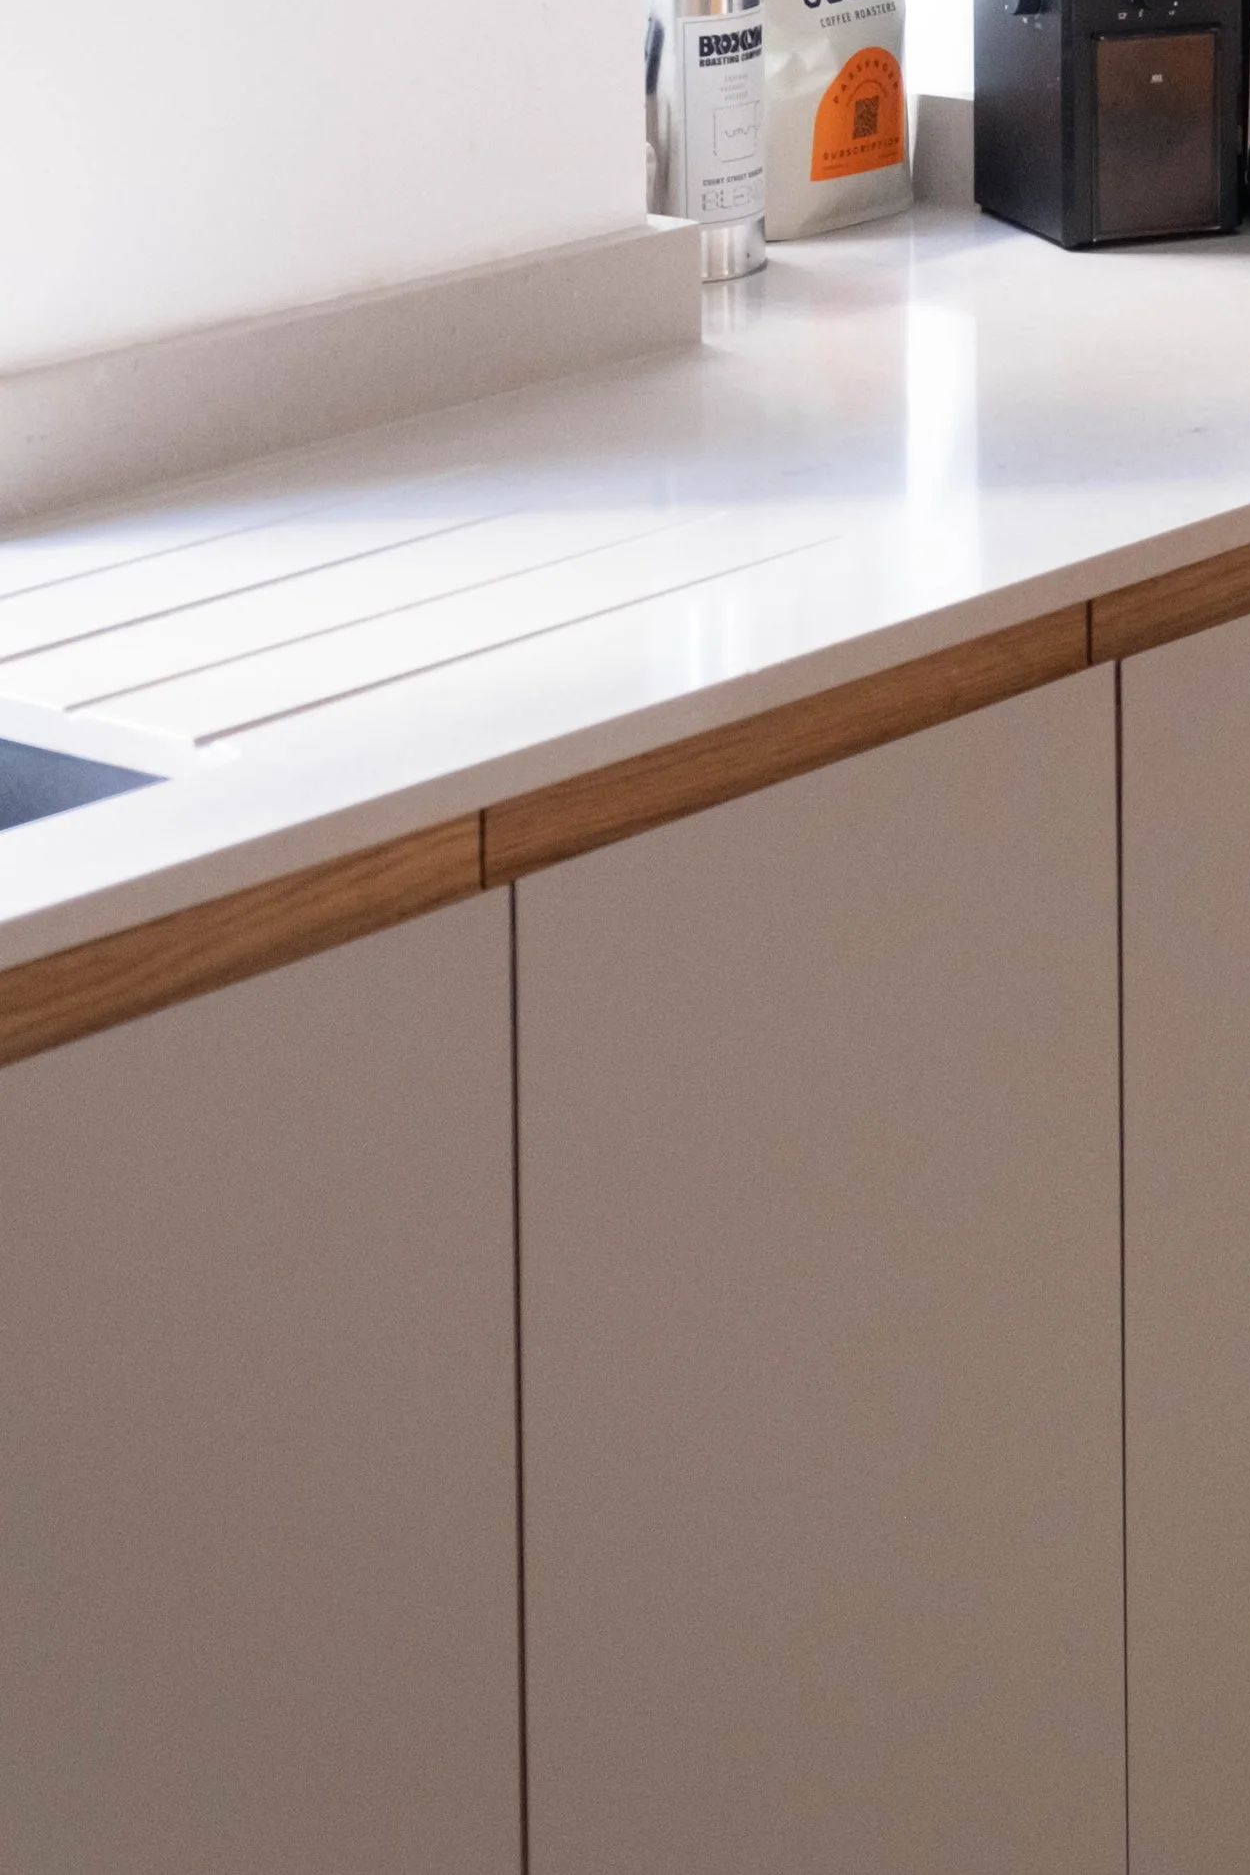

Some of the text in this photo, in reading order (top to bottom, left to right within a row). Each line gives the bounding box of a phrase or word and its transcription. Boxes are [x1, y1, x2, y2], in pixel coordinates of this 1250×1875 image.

[820, 1, 897, 29] COFFEE ROASTERS
[699, 54, 740, 68] ROASTING
[822, 136, 900, 161] SUBSCRIPTION
